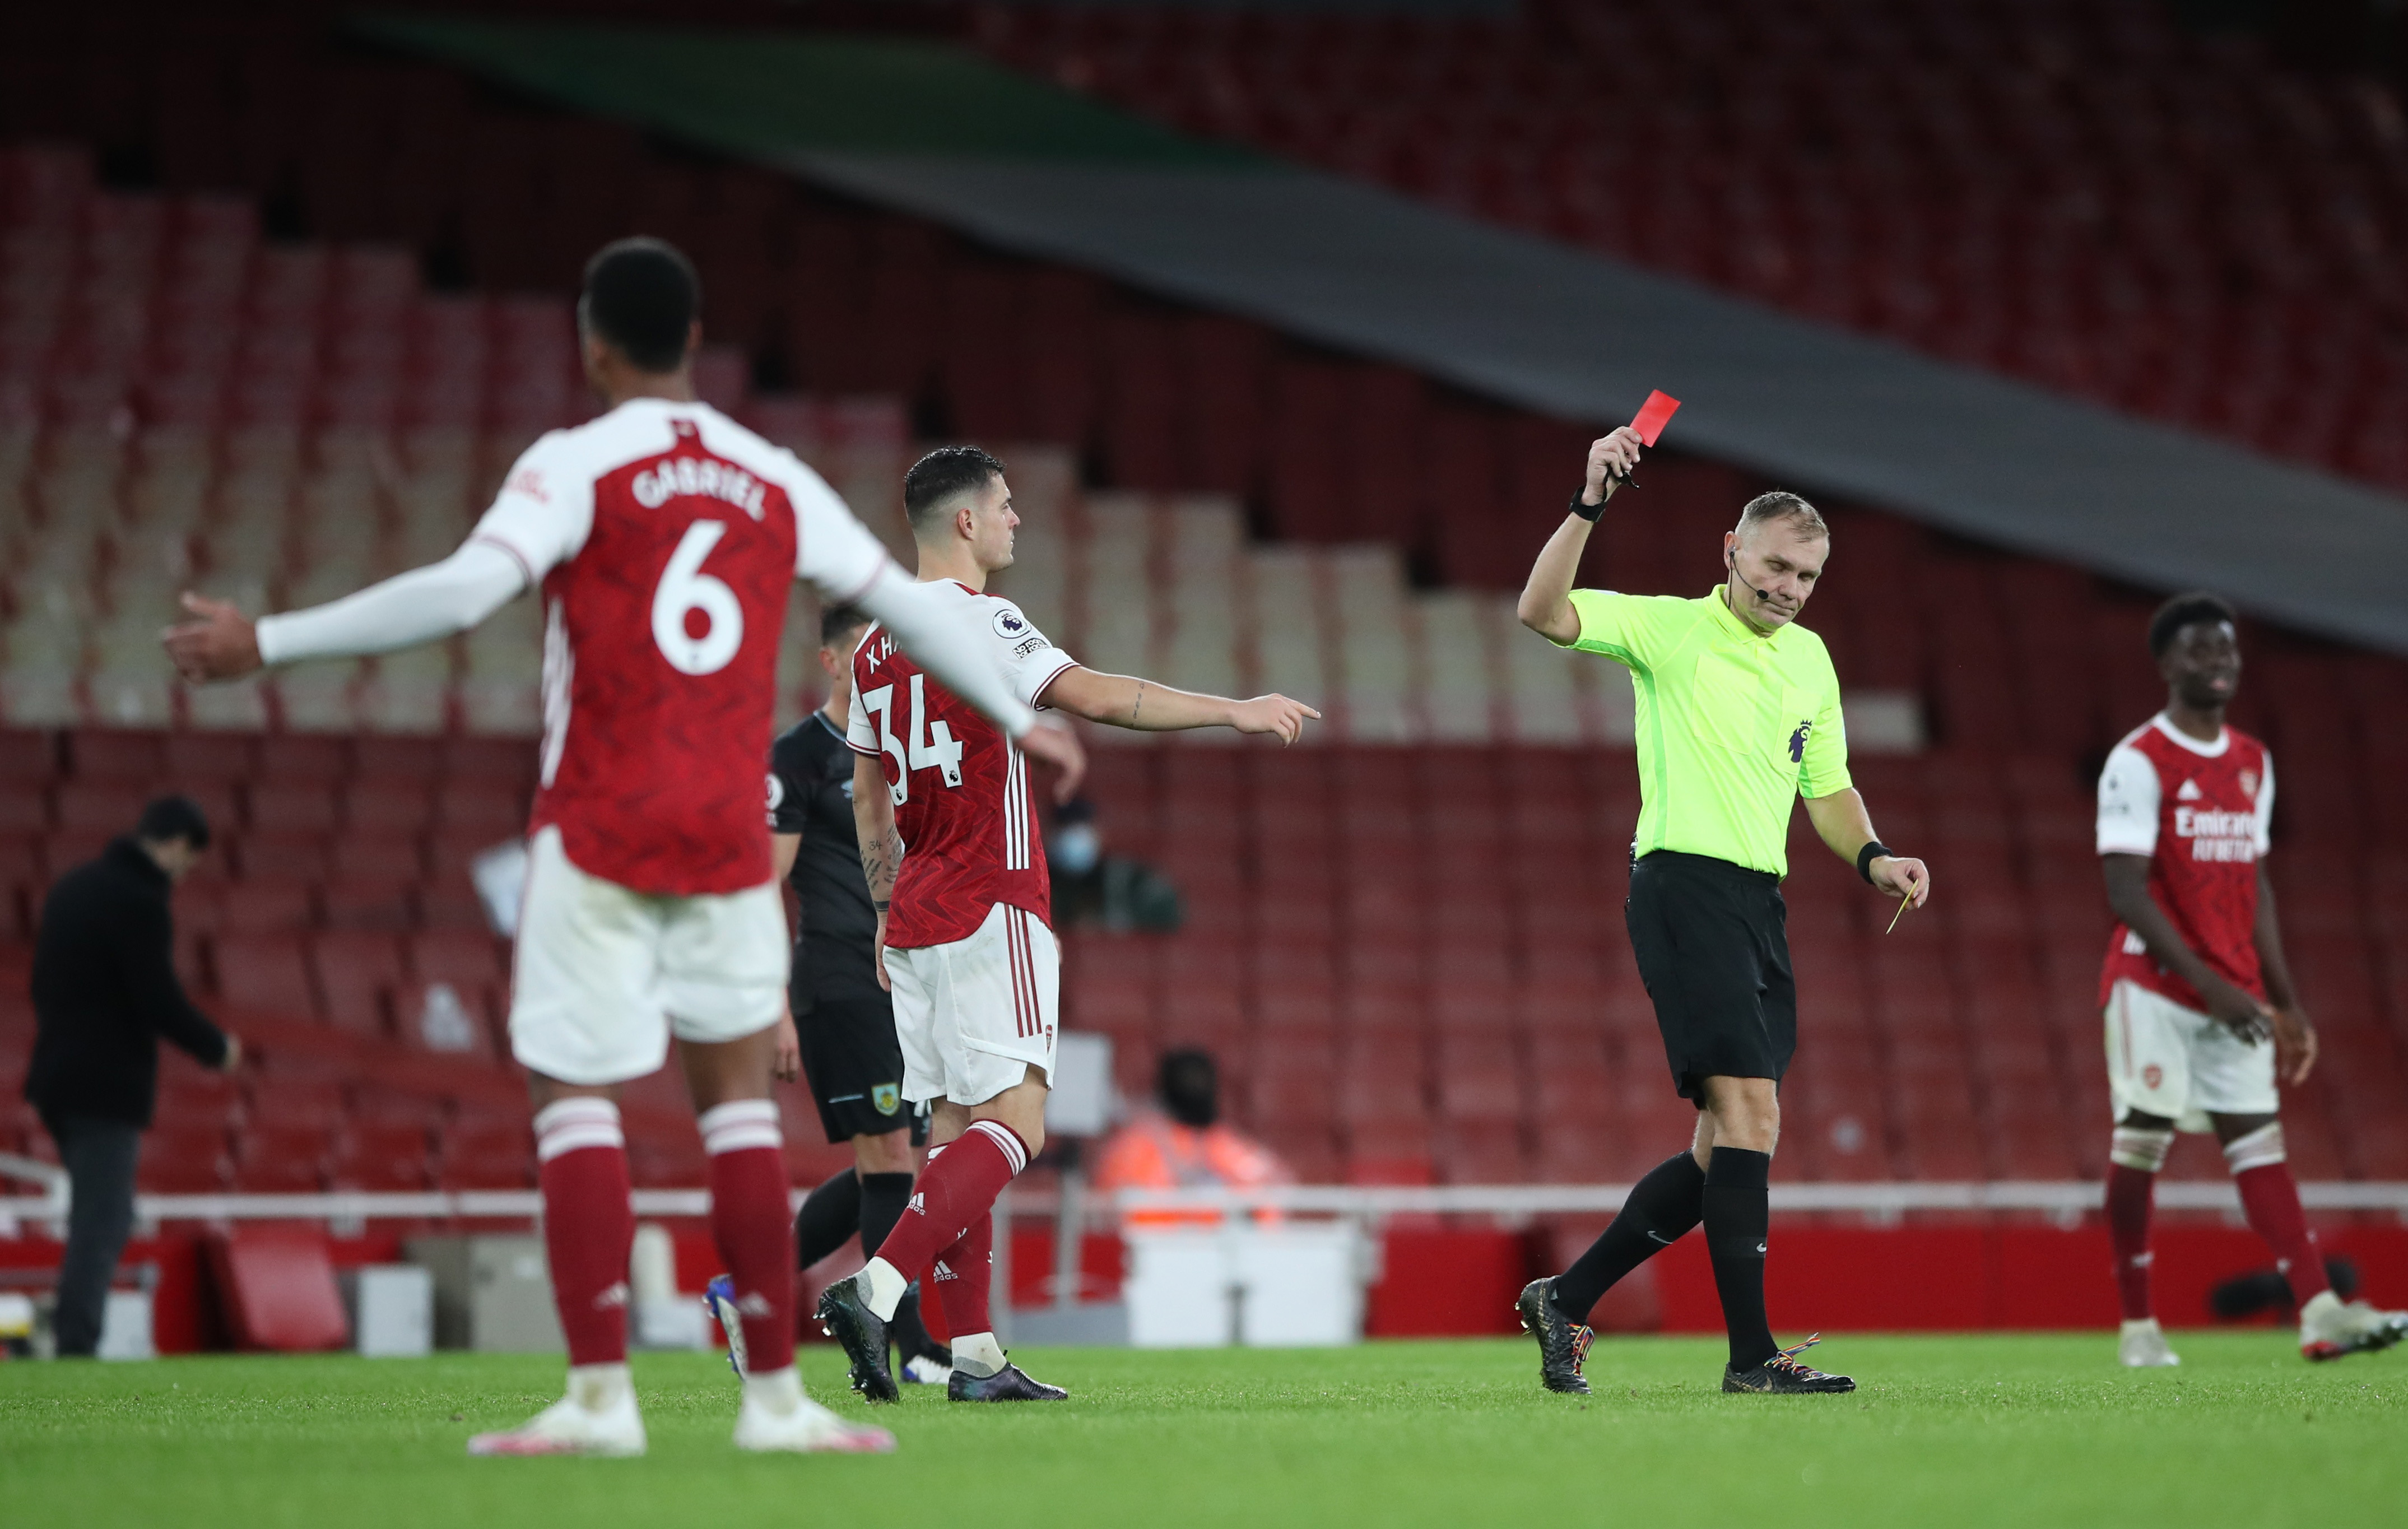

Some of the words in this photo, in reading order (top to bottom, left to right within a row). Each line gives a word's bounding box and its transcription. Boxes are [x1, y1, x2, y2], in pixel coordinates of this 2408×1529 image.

[631, 456, 766, 522] GABRIEL
[650, 518, 745, 676] 6
[862, 673, 963, 806] 34
